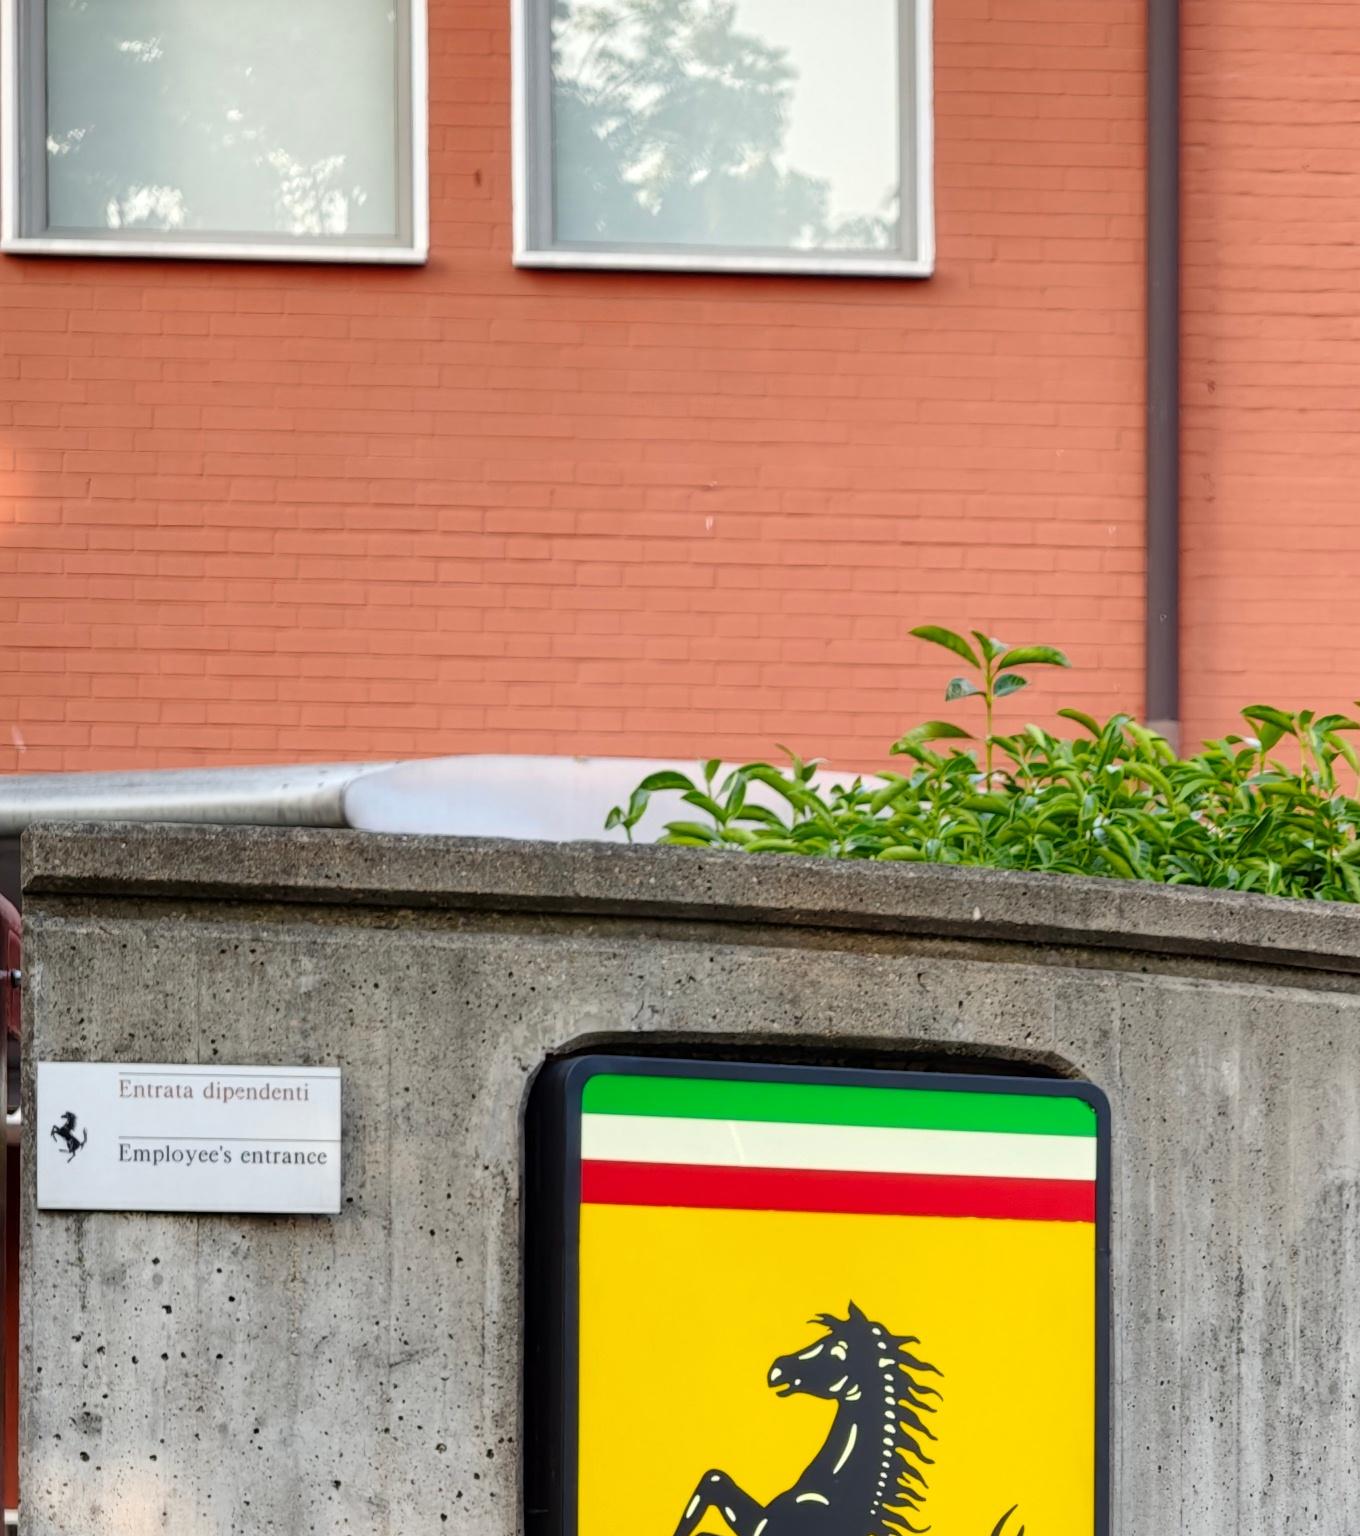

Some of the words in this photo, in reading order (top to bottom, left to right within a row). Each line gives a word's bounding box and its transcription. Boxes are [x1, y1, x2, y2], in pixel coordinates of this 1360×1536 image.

[118, 1079, 194, 1099] Entrata
[202, 1081, 310, 1104] dipendenti
[118, 1143, 232, 1167] Employee's
[240, 1149, 328, 1165] entrance
